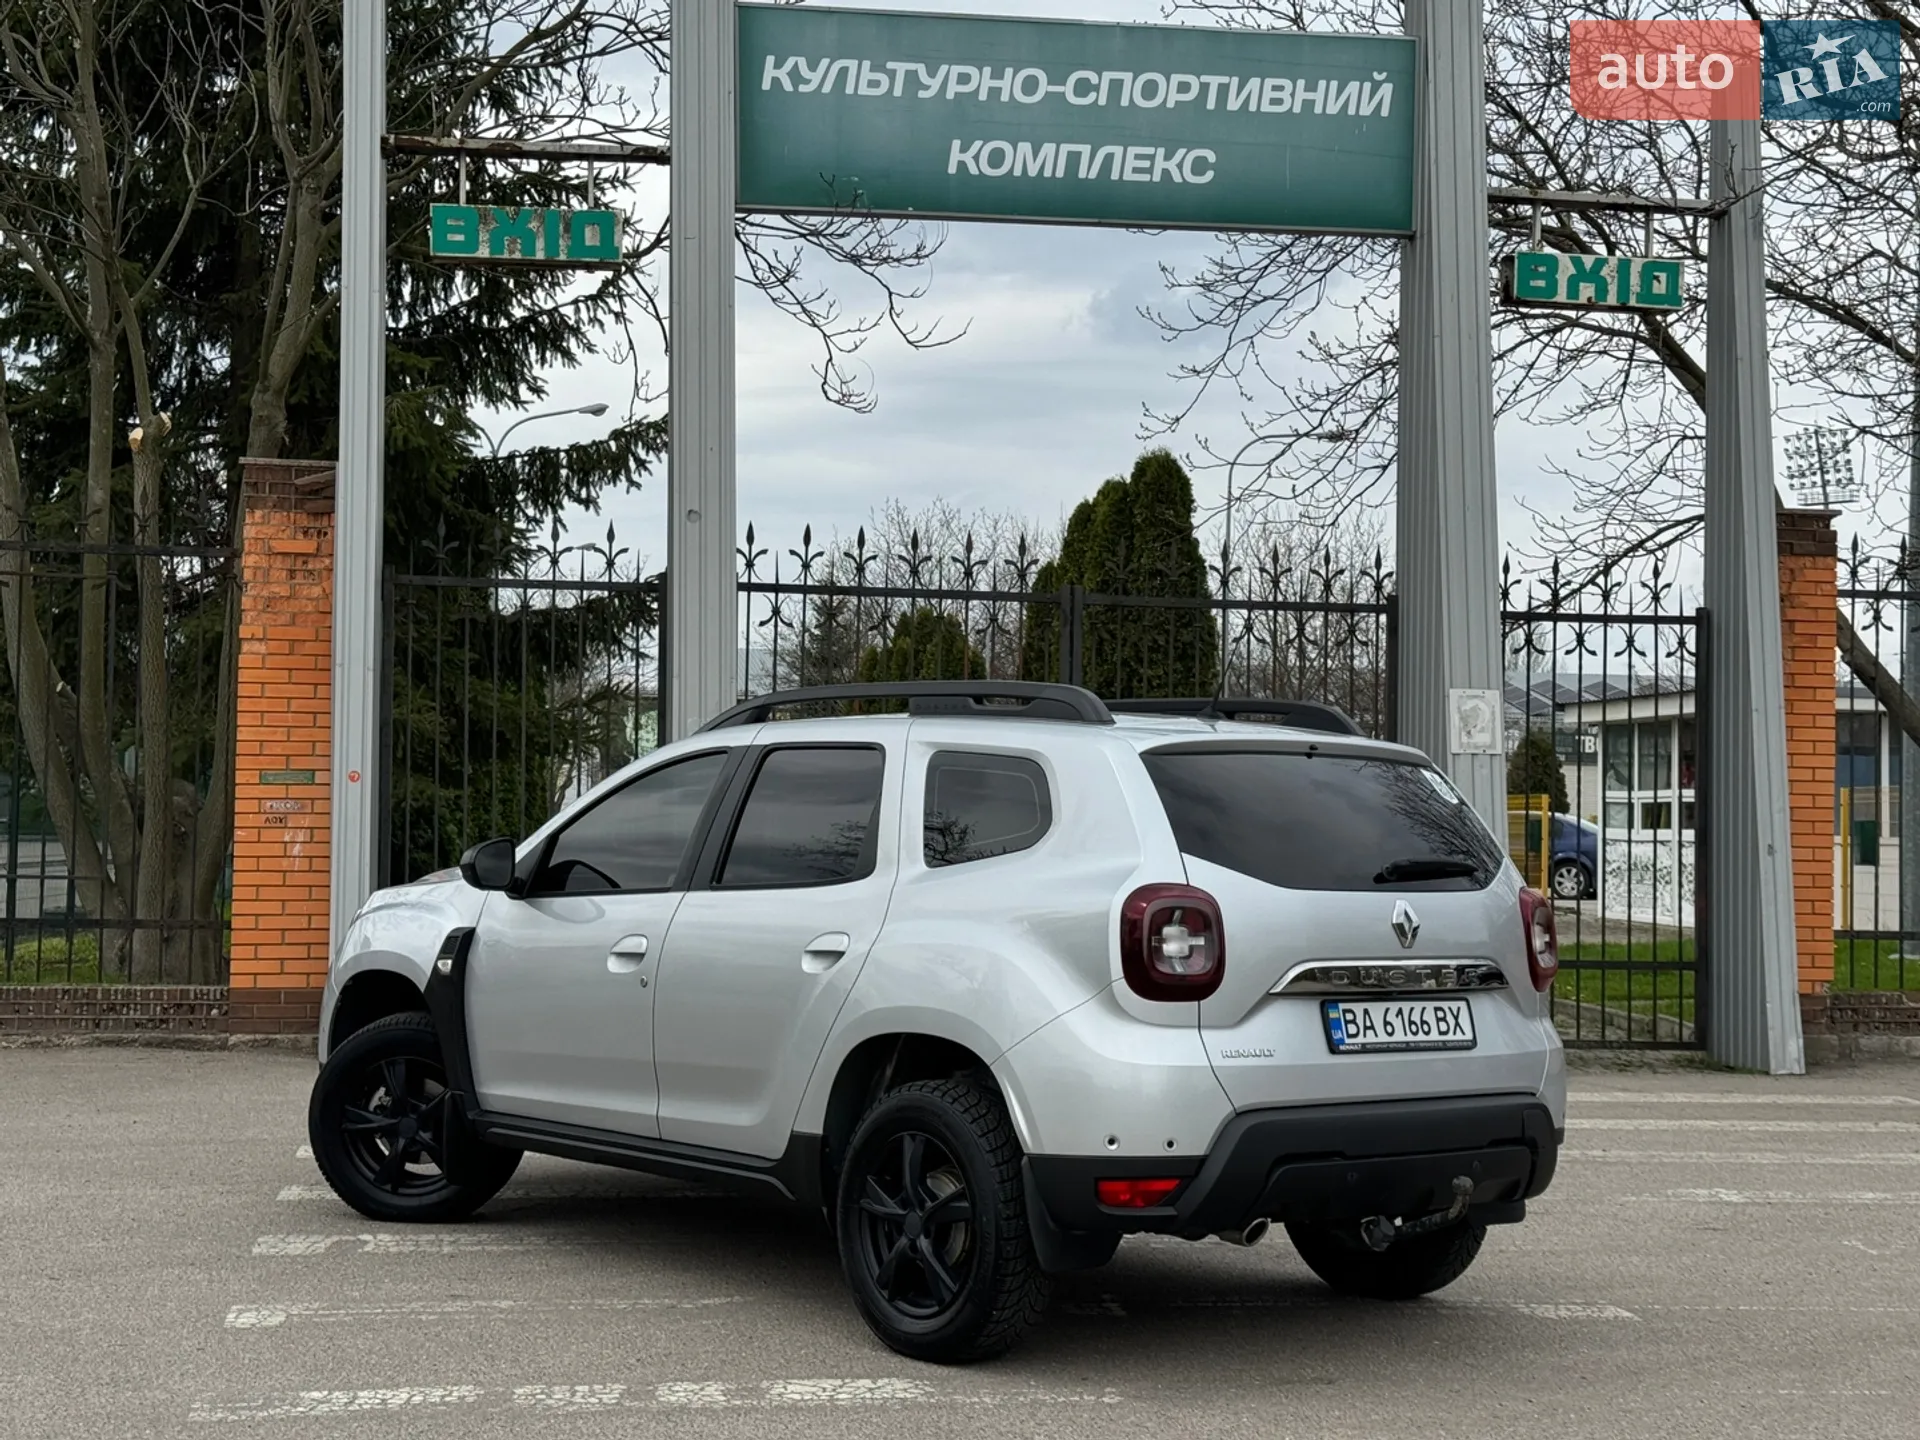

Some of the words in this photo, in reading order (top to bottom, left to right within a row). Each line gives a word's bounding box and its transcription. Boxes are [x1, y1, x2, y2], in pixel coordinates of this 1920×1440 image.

[762, 54, 1394, 117] КУЛЬТУРНО-СПОРТИВНИЙ
[947, 138, 1216, 184] КОМПЛЕКС
[432, 205, 622, 259] ВХІД
[1516, 252, 1682, 307] ВХІД
[1331, 968, 1480, 987] DUSTER
[1383, 1007, 1431, 1038] 6166
[1220, 1048, 1276, 1059] RENAULT
